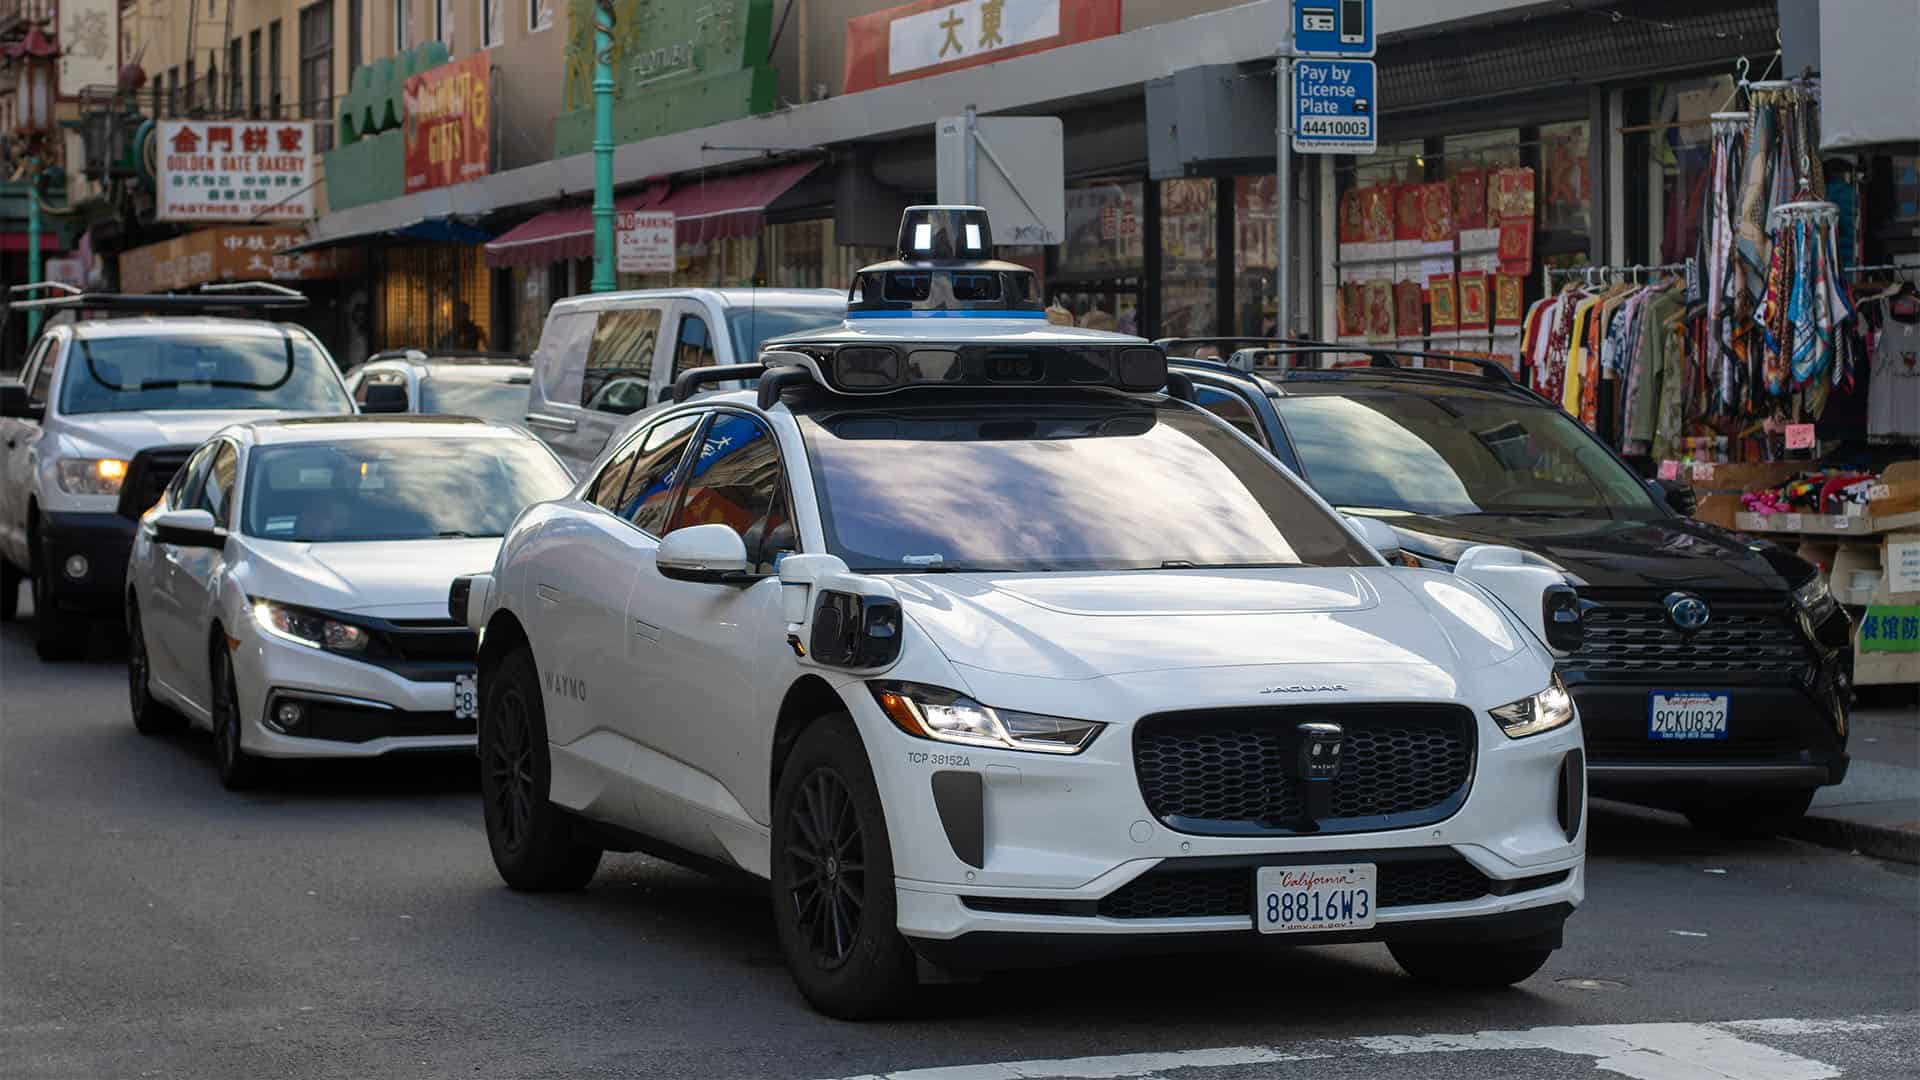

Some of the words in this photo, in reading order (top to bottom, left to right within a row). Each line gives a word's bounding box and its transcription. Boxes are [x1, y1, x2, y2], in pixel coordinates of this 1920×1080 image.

[939, 0, 1004, 57] 大東
[1300, 65, 1328, 83] Pay
[1332, 64, 1351, 84] by
[1300, 80, 1356, 97] License
[1300, 98, 1339, 113] Plate
[1303, 121, 1368, 135] 44410003
[170, 125, 303, 152] 金門餅家
[167, 155, 214, 172] GOLDEN
[221, 155, 252, 172] GATE
[257, 155, 305, 172] BAKERY
[544, 672, 585, 702] WAYMO
[1259, 684, 1348, 695] JAGUAR
[1656, 710, 1724, 732] 9CKU832
[908, 752, 929, 763] TCP
[931, 754, 970, 767] 38152A
[1282, 871, 1346, 890] California
[1267, 889, 1369, 923] 88816W3
